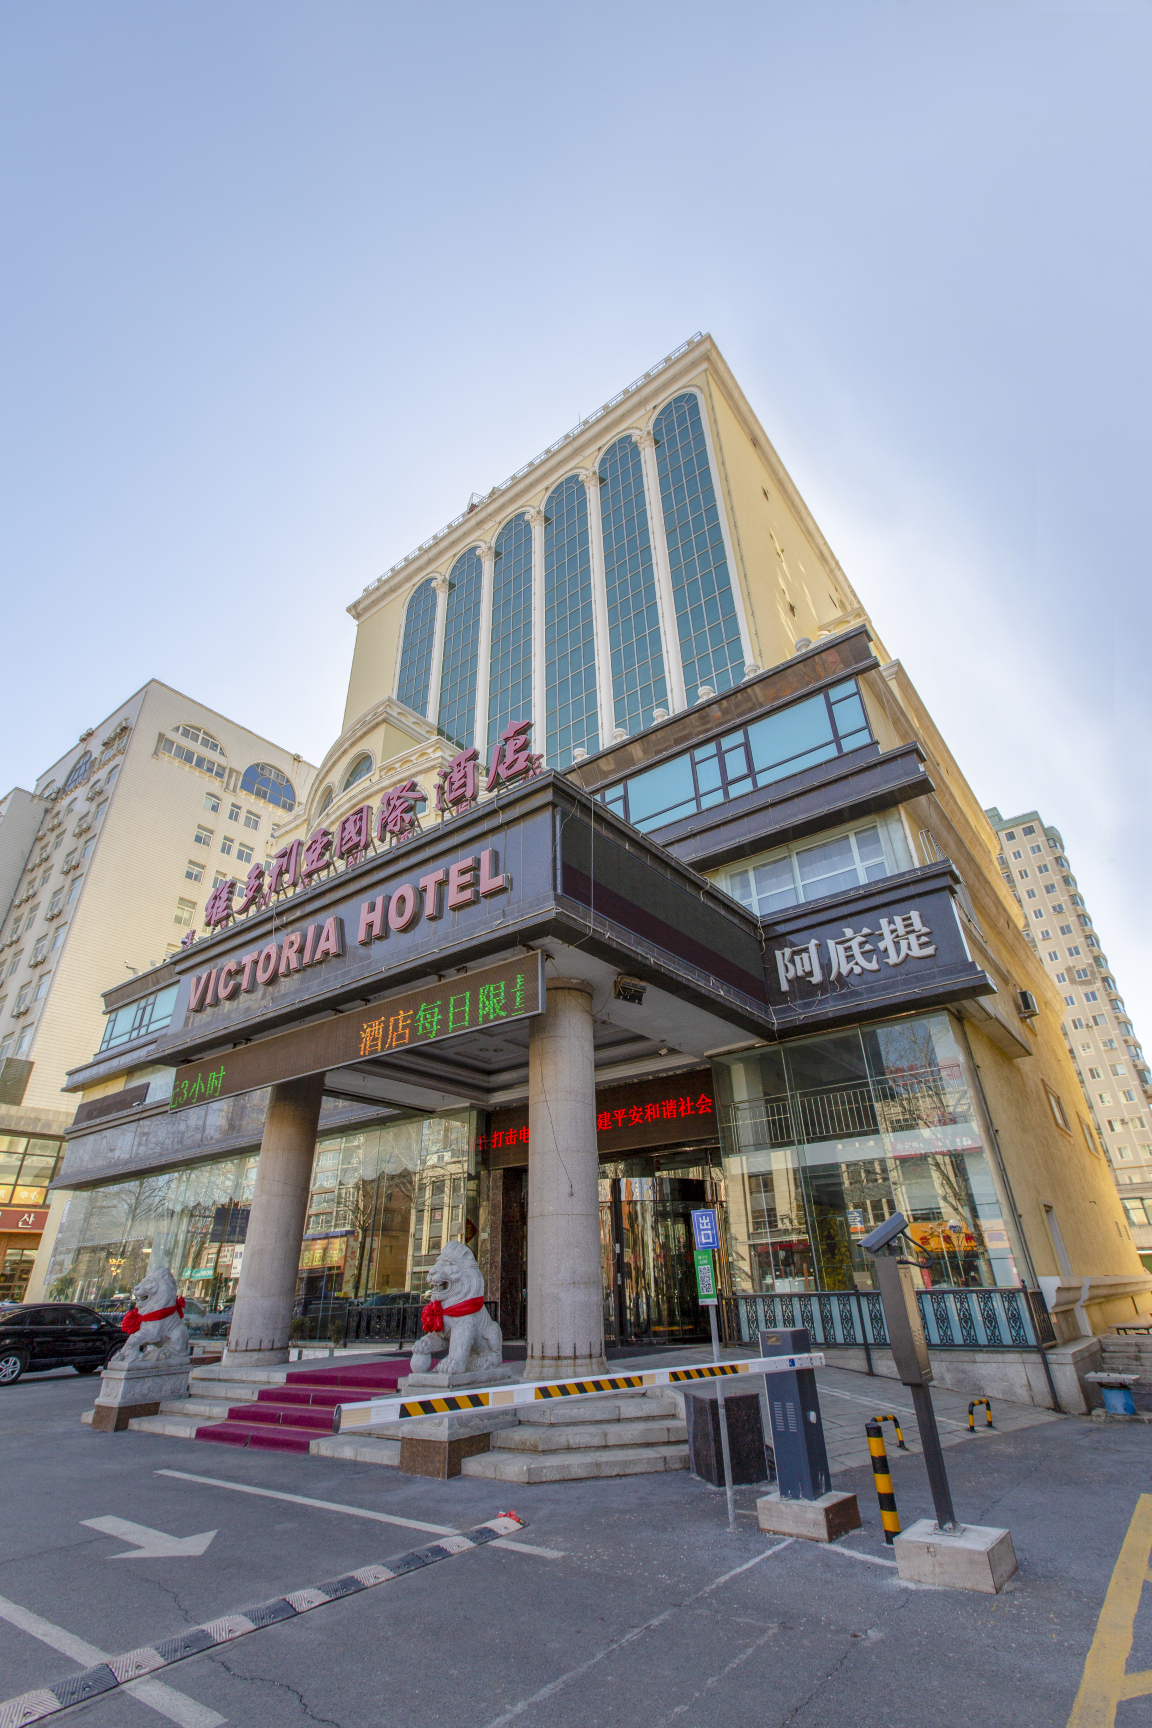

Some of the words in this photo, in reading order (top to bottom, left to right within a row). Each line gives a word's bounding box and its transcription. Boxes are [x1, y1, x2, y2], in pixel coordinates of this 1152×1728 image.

[188, 915, 343, 1012] VICTORIA
[357, 848, 508, 945] HOTEL
[775, 910, 937, 992] 阿底提
[596, 1093, 713, 1132] 建平安和谐社会
[698, 1215, 713, 1244] 出口
